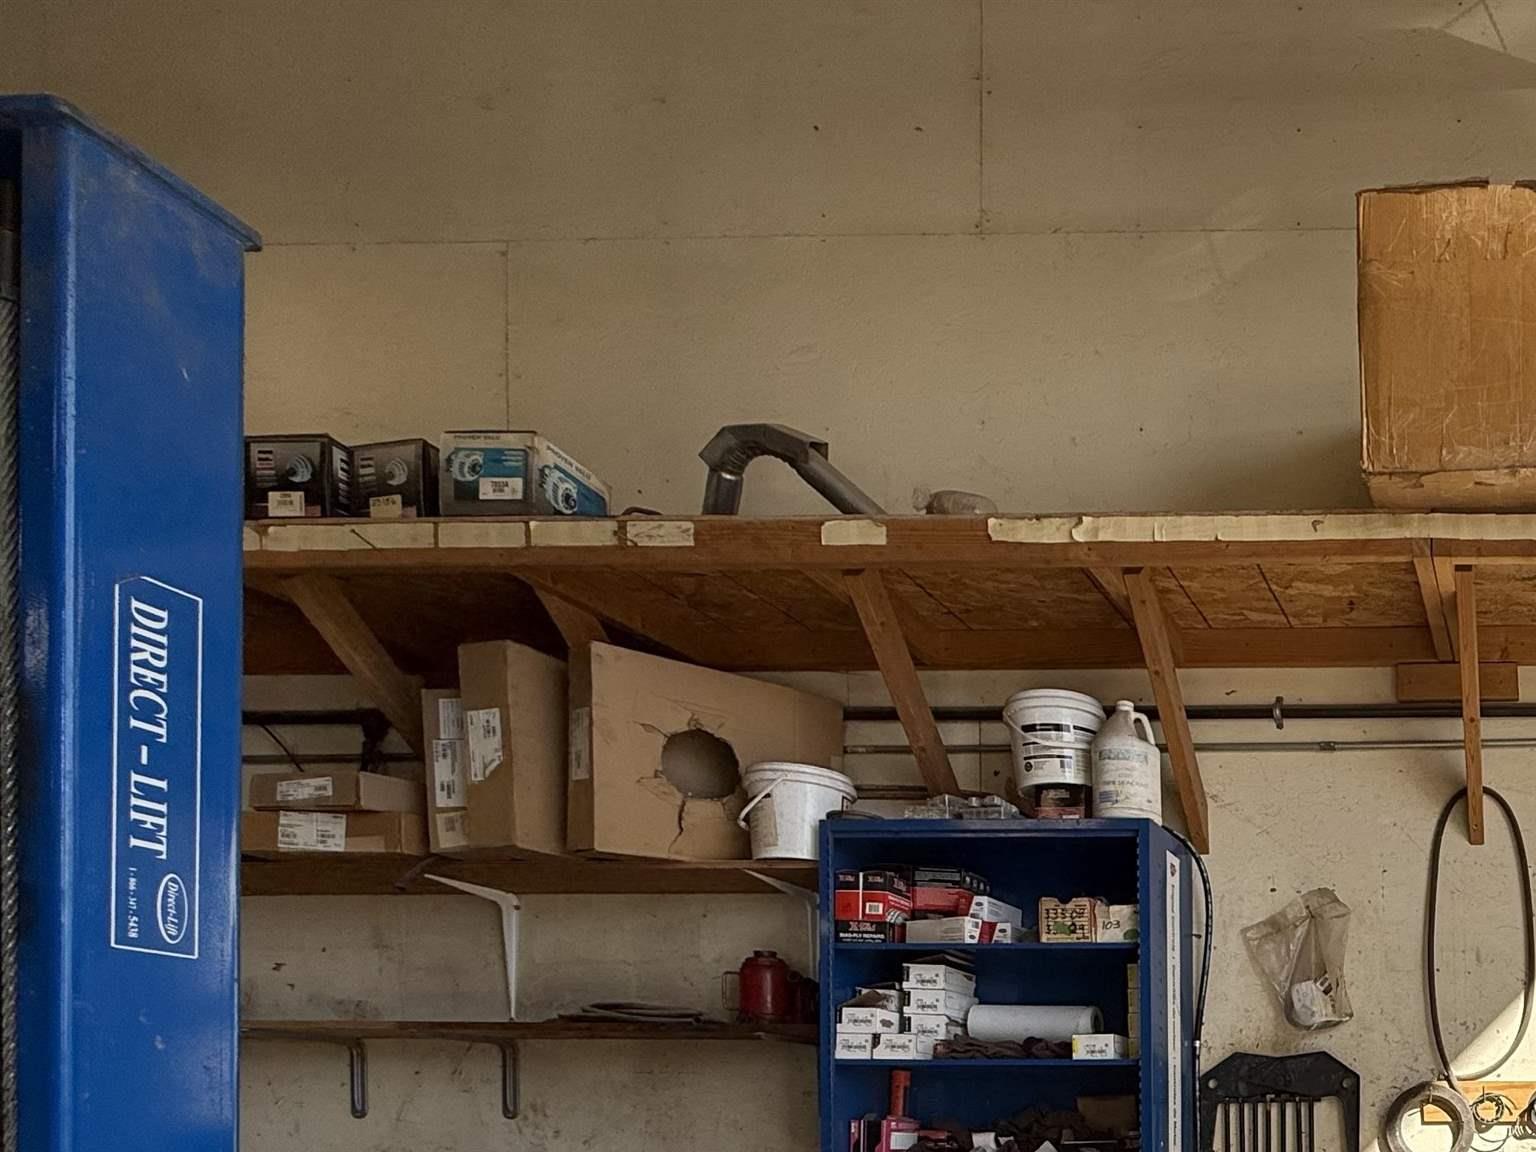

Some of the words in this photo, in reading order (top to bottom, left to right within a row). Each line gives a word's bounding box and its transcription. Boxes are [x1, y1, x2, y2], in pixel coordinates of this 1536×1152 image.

[129, 595, 169, 743] DIRECT
[128, 770, 168, 860] LIFT
[165, 880, 180, 937] Direct-Lift
[1102, 919, 1121, 931] 103
